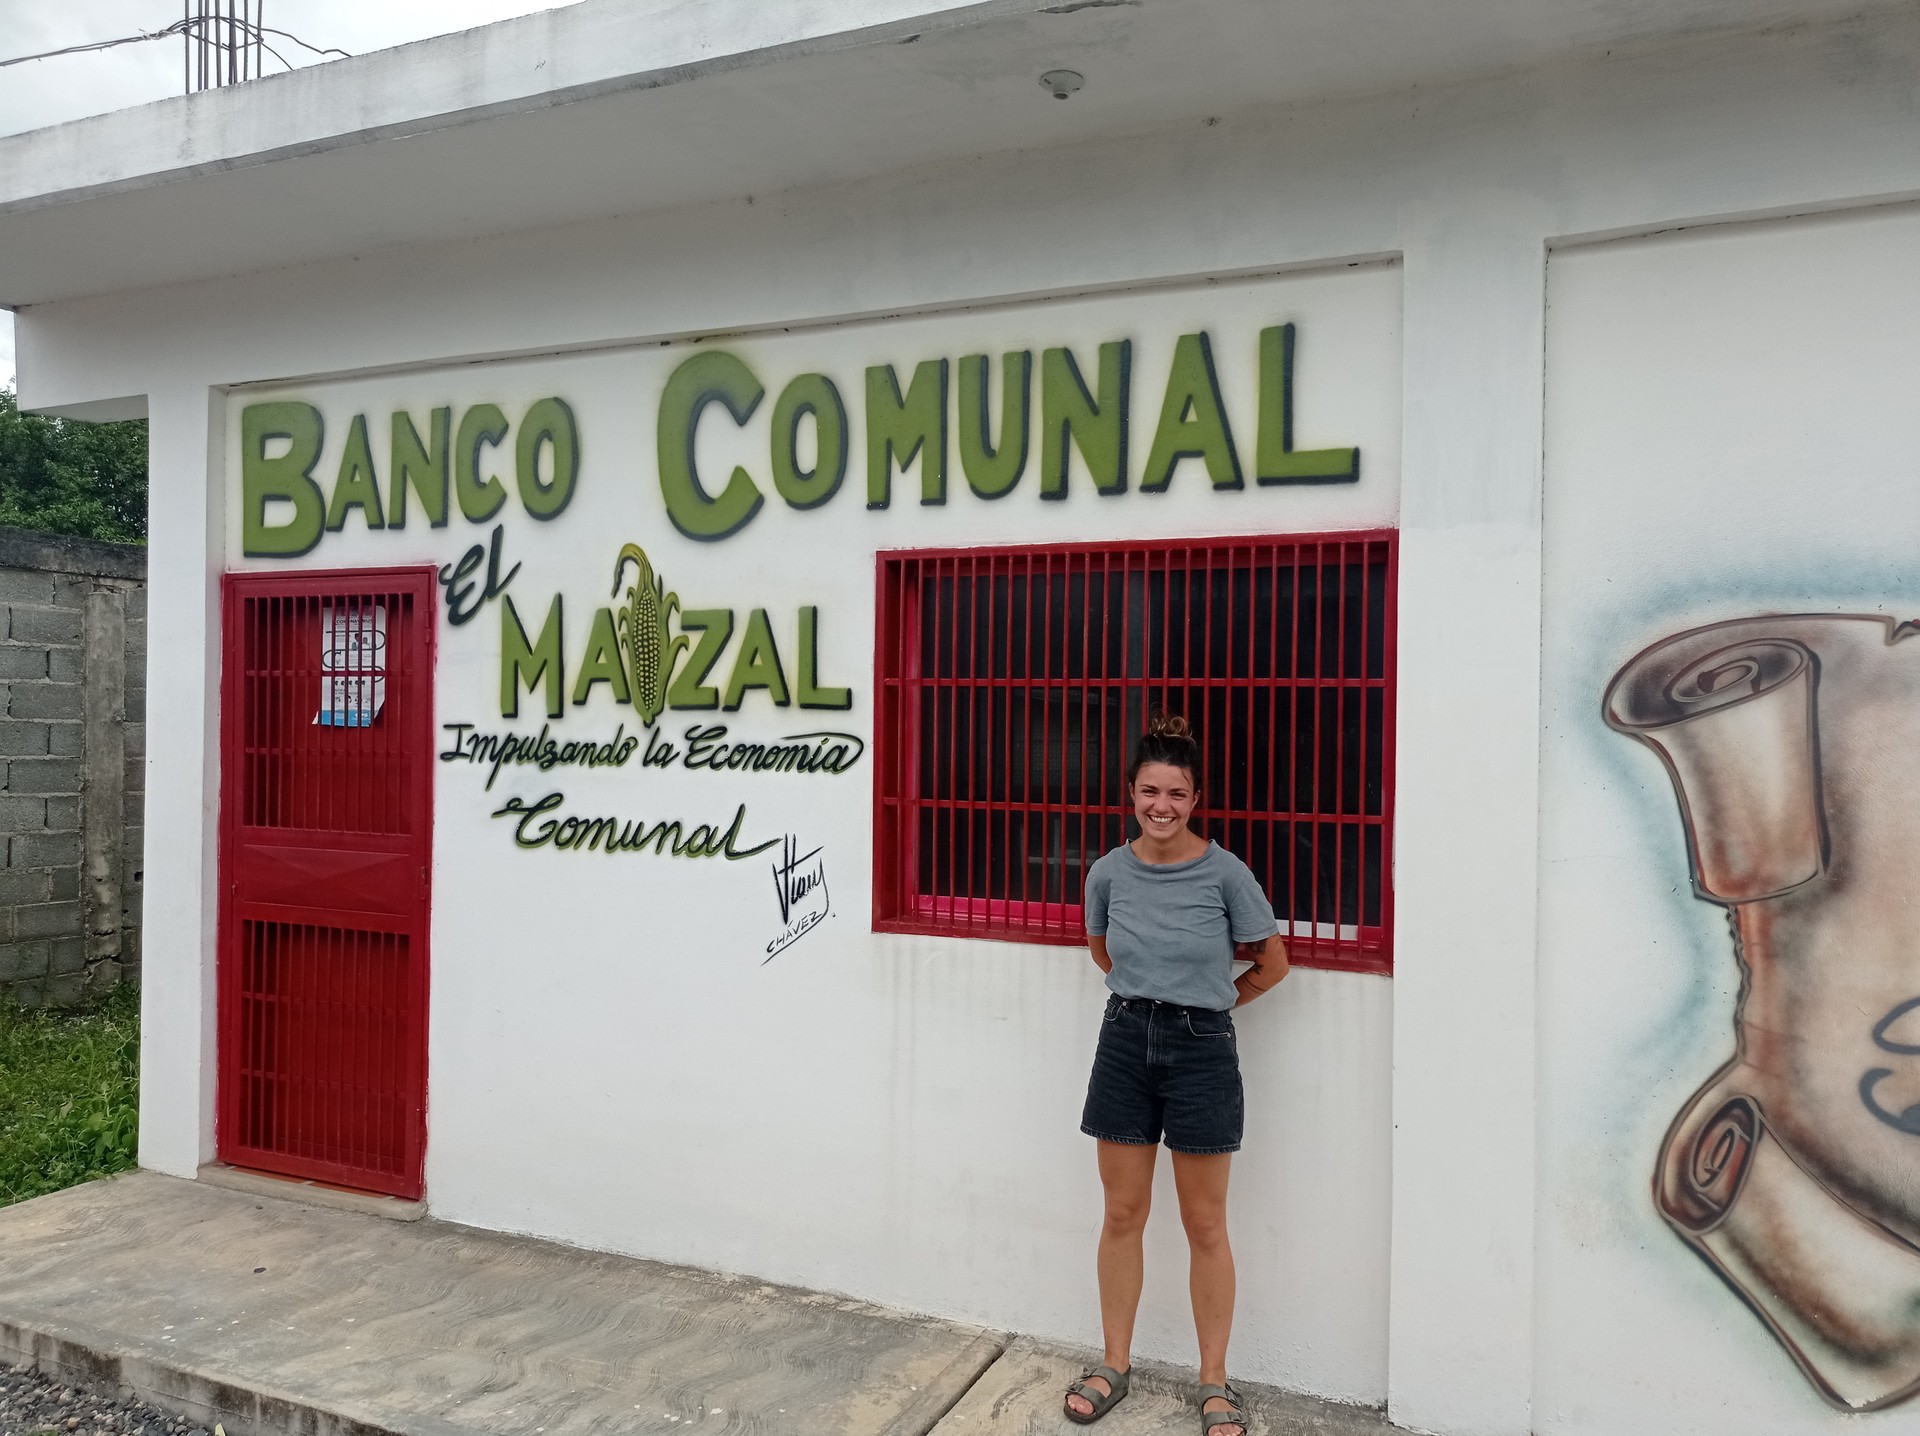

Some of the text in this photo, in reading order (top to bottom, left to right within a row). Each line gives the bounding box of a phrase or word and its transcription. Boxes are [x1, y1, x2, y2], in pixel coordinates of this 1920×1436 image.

[242, 323, 1361, 558] BANCO COMUNAL
[438, 525, 522, 626] El
[641, 726, 681, 769] la
[491, 792, 783, 860] Comunal
